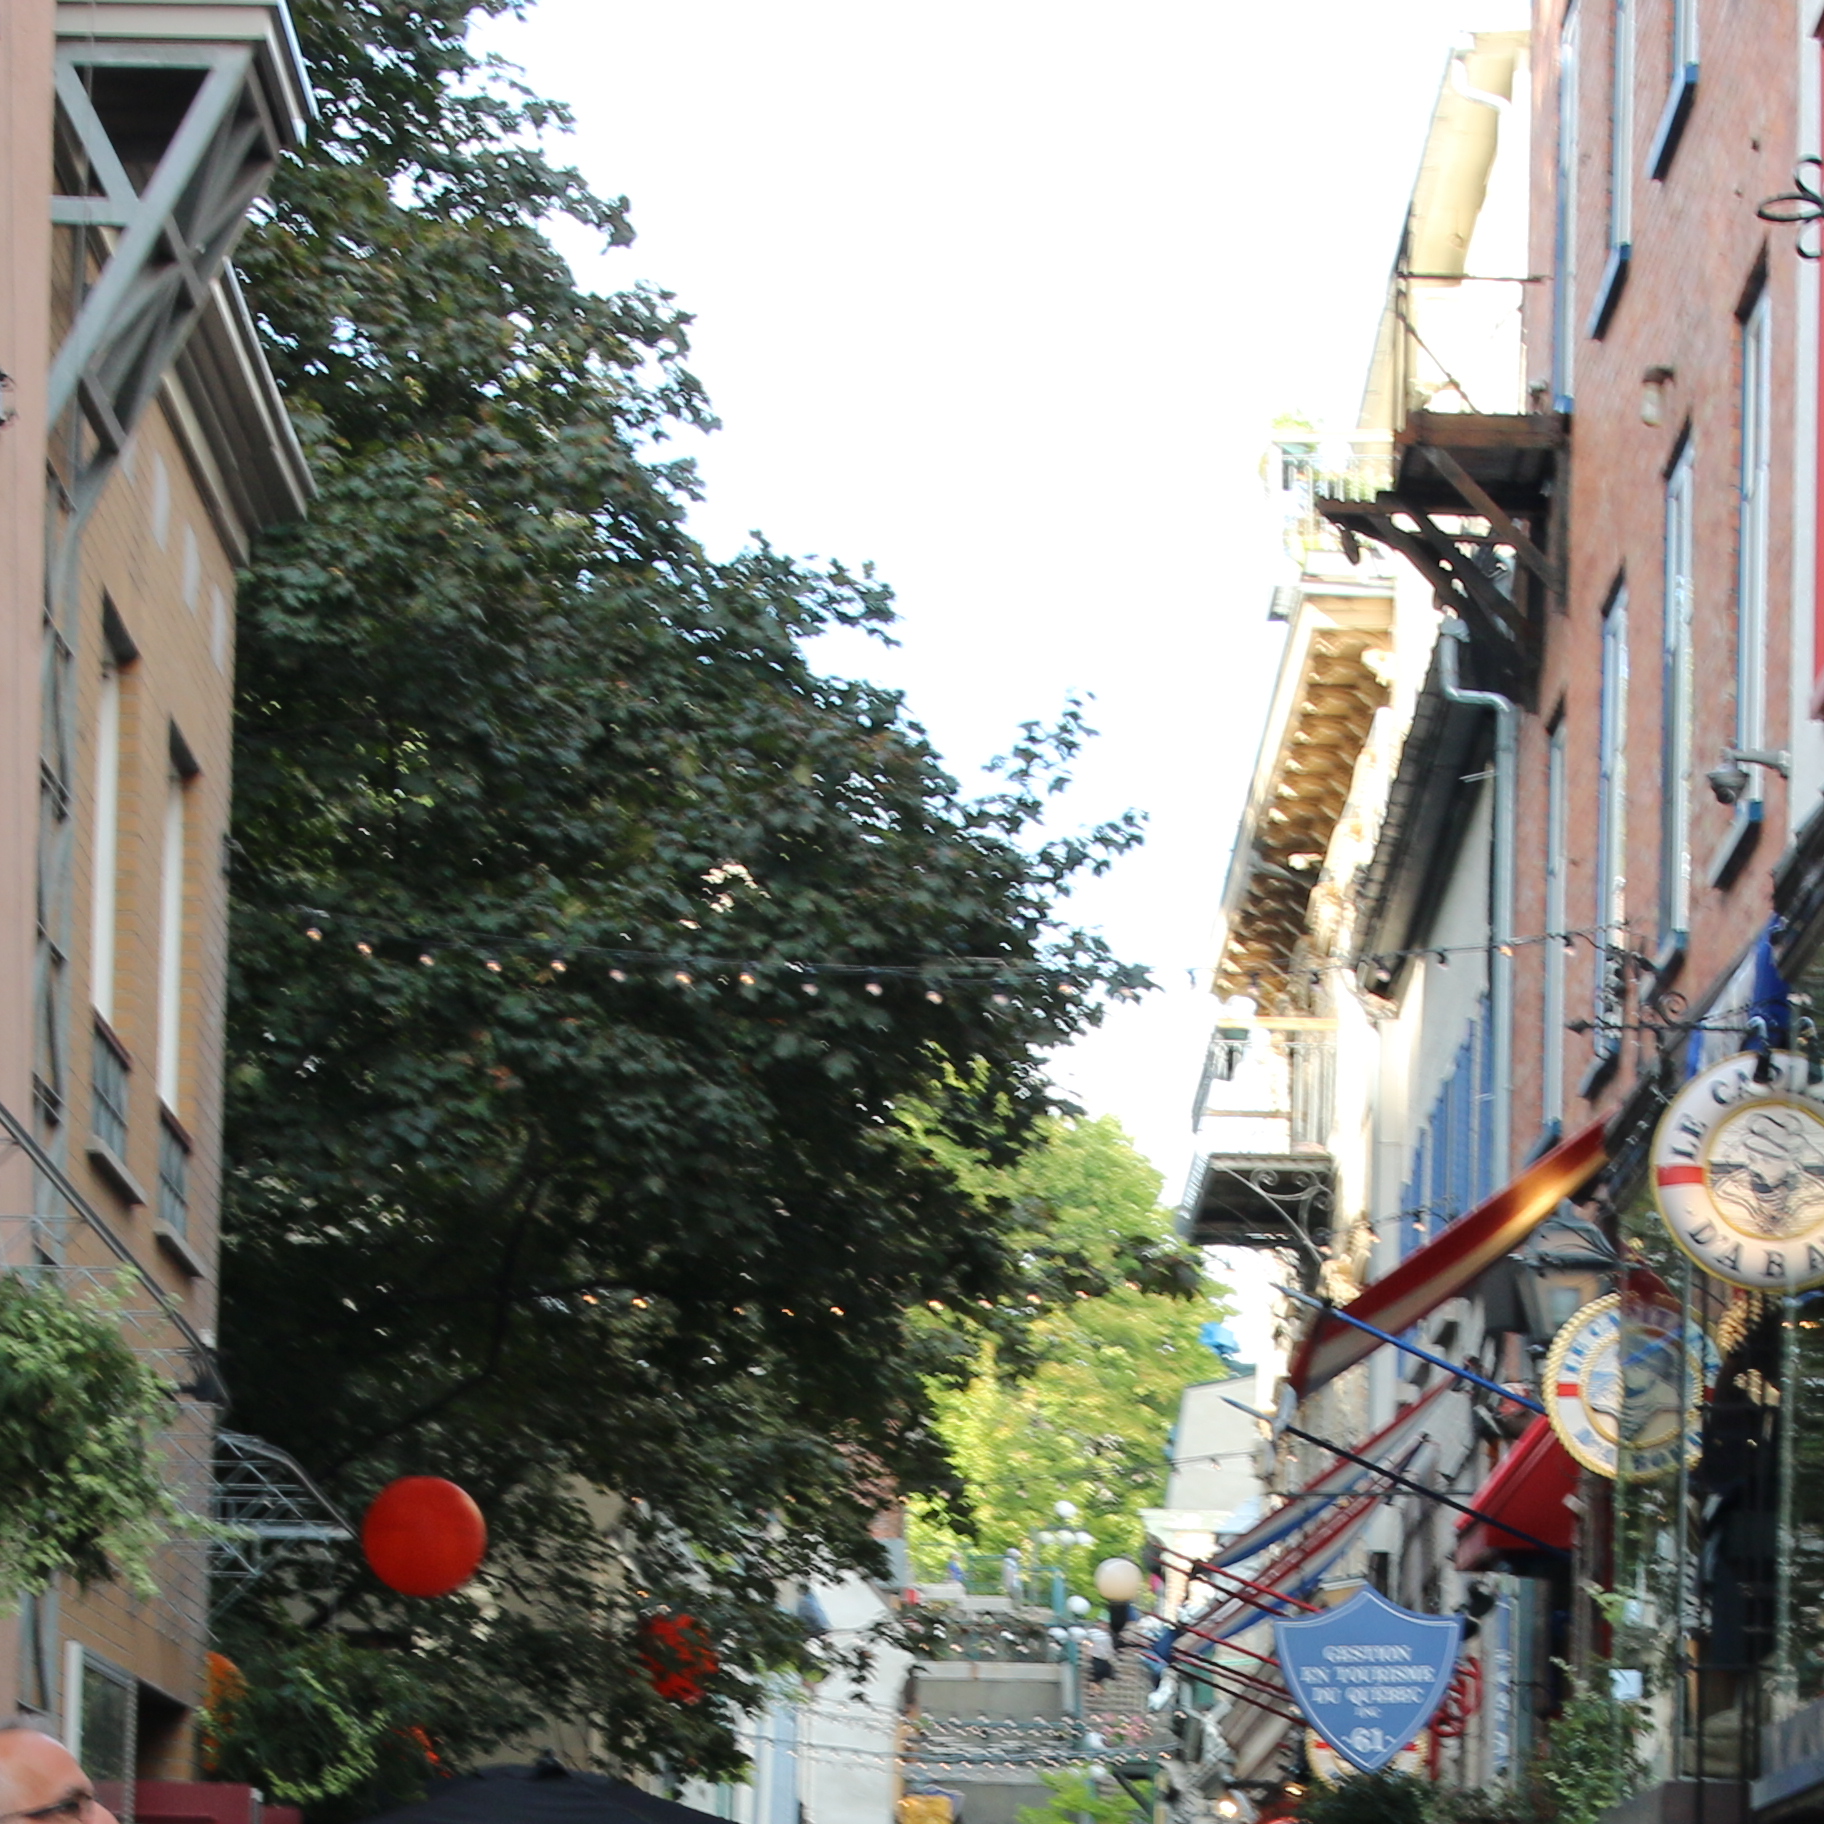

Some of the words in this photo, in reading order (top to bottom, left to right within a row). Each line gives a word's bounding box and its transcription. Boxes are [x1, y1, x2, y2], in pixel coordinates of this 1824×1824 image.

[1322, 1645, 1412, 1663] GESTION
[1300, 1666, 1330, 1684] EN
[1333, 1665, 1436, 1684] TOURISME
[1311, 1686, 1342, 1705] DU
